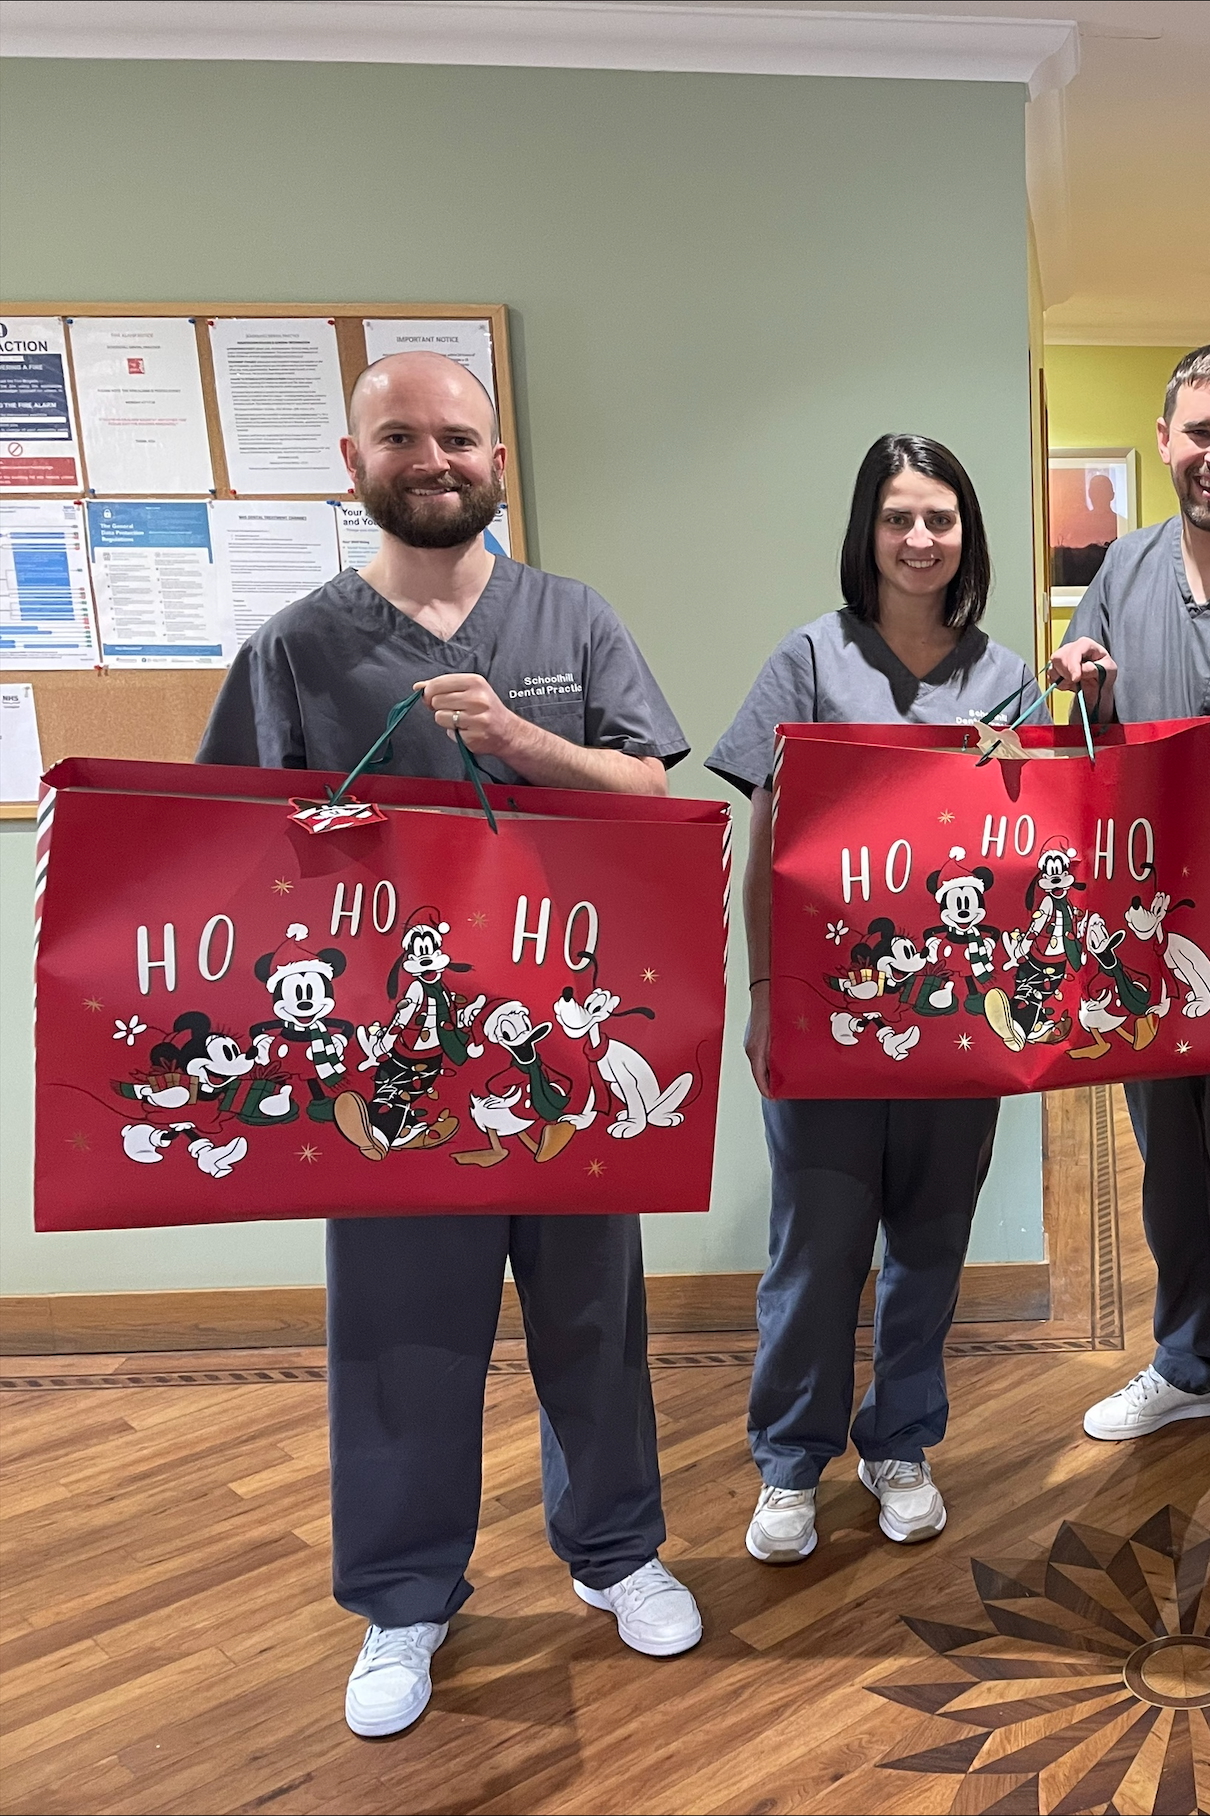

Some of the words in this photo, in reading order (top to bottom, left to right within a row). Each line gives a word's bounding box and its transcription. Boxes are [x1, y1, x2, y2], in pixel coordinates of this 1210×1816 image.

[343, 518, 360, 526] and
[523, 673, 574, 686] Schoolhill
[509, 686, 546, 699] Dental
[840, 838, 912, 904] HO
[981, 813, 1036, 858] HO
[1093, 817, 1155, 882] HO
[137, 914, 235, 995] HO
[330, 879, 397, 937] HO
[511, 894, 599, 971] HO
